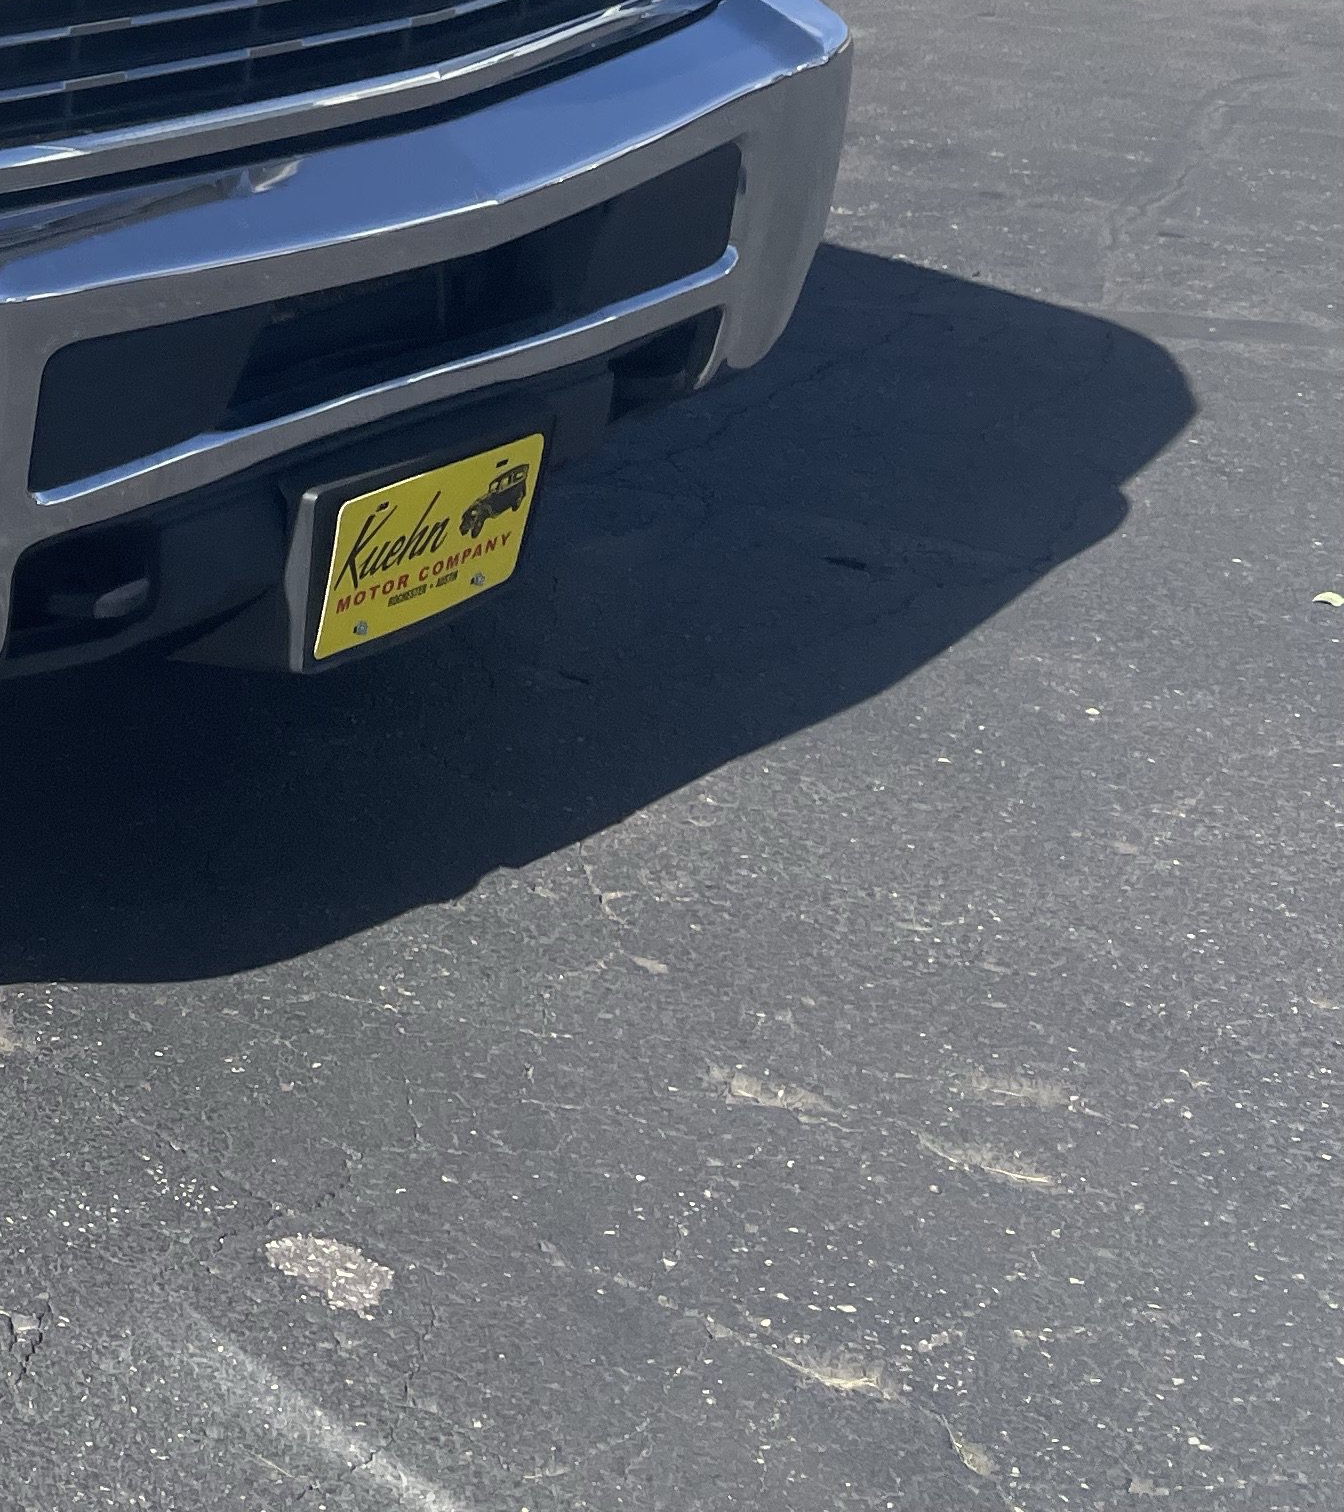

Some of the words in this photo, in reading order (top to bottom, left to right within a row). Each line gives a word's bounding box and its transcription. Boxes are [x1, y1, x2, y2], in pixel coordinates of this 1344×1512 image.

[334, 491, 449, 591] Kuehn
[336, 574, 409, 614] MOTOR
[418, 531, 511, 582] COMPANY
